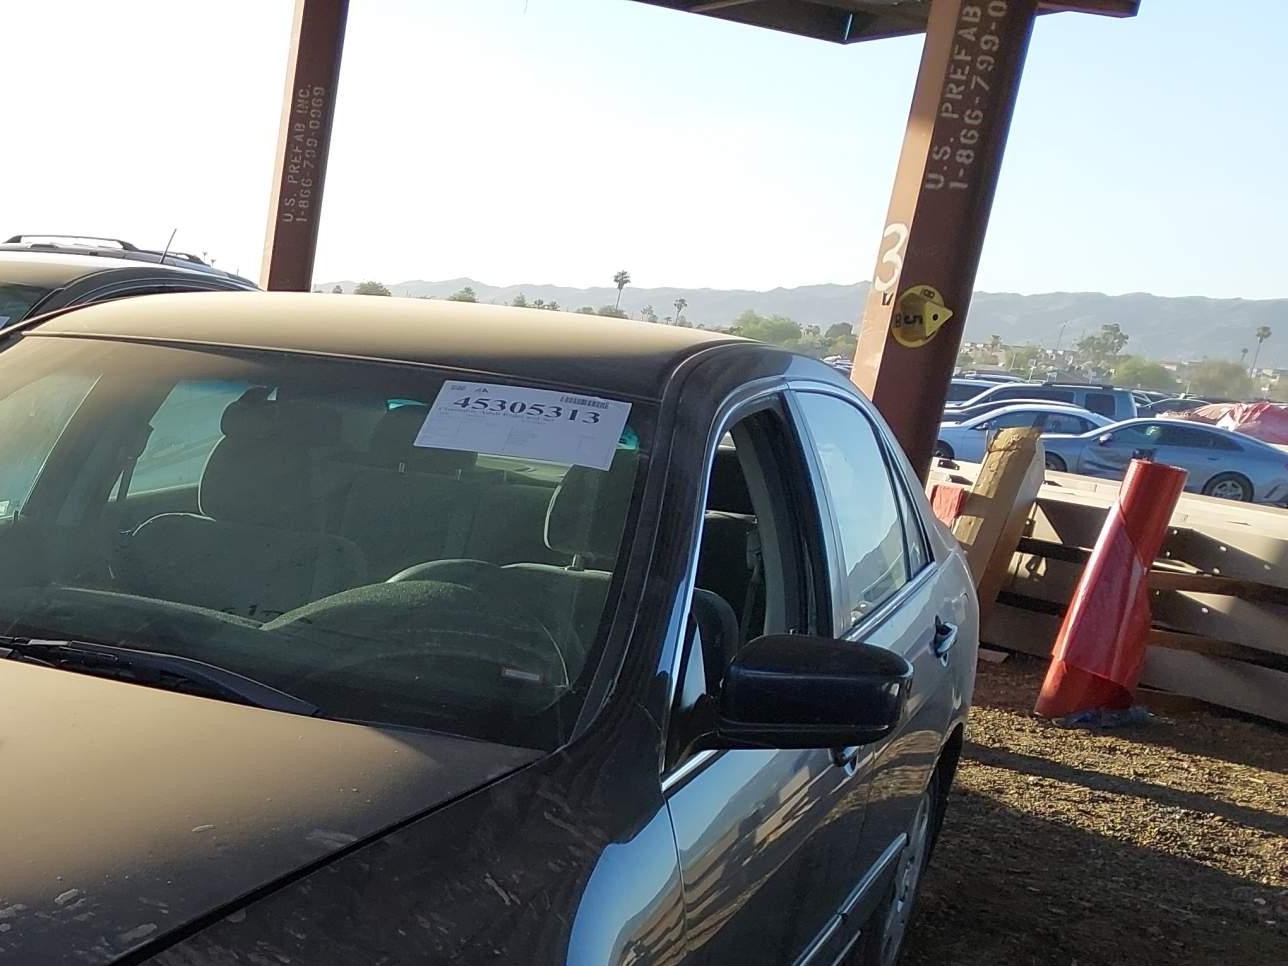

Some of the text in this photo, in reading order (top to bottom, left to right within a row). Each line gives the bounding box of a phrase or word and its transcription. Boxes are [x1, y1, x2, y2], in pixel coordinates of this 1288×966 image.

[282, 84, 312, 222] U.S. PREFAB INC.
[296, 86, 325, 222] 1-866-799-0969
[925, 5, 982, 190] U.S. PREFAB
[875, 223, 908, 292] 3
[453, 396, 601, 425] 45305313
